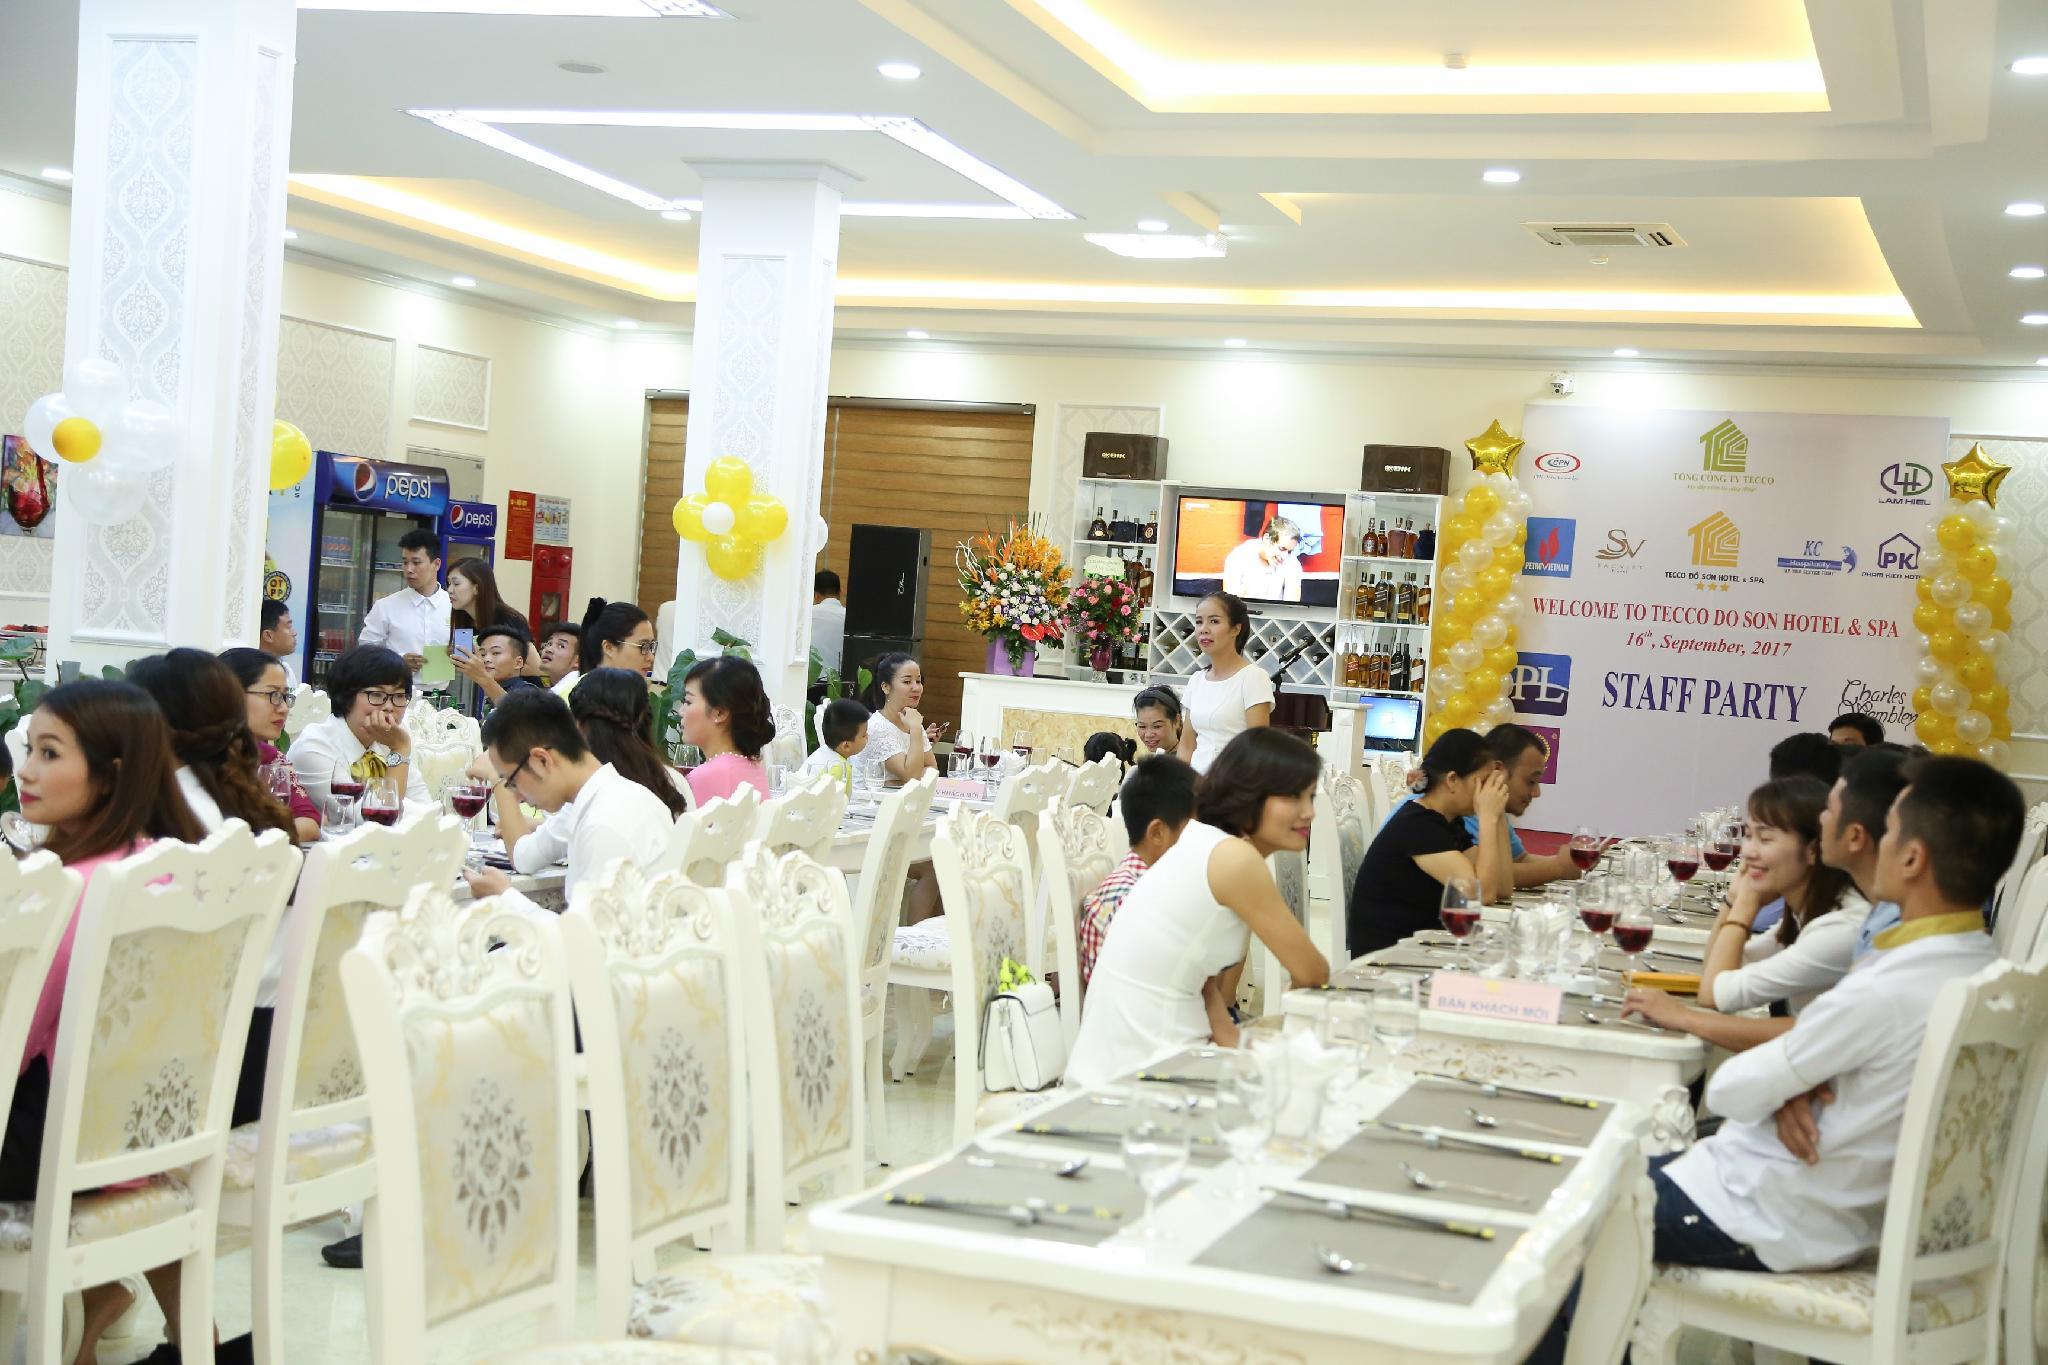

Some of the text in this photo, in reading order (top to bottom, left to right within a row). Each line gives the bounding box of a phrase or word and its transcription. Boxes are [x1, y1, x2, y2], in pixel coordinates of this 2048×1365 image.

[385, 474, 431, 502] pepsi
[465, 511, 493, 528] pepsi
[1803, 540, 1823, 557] KC
[1882, 551, 1915, 570] PK
[1664, 571, 1686, 579] TECCO
[1718, 574, 1741, 583] HOTEL
[1749, 576, 1765, 584] SPA
[1533, 597, 1900, 638] WELCOME TO TECCO DO SON HOTEL & SPA
[1659, 634, 1746, 655] September,
[1751, 640, 1792, 657] 2017
[1602, 671, 1808, 723] STAFF PARTY
[1842, 678, 1907, 706] Charles
